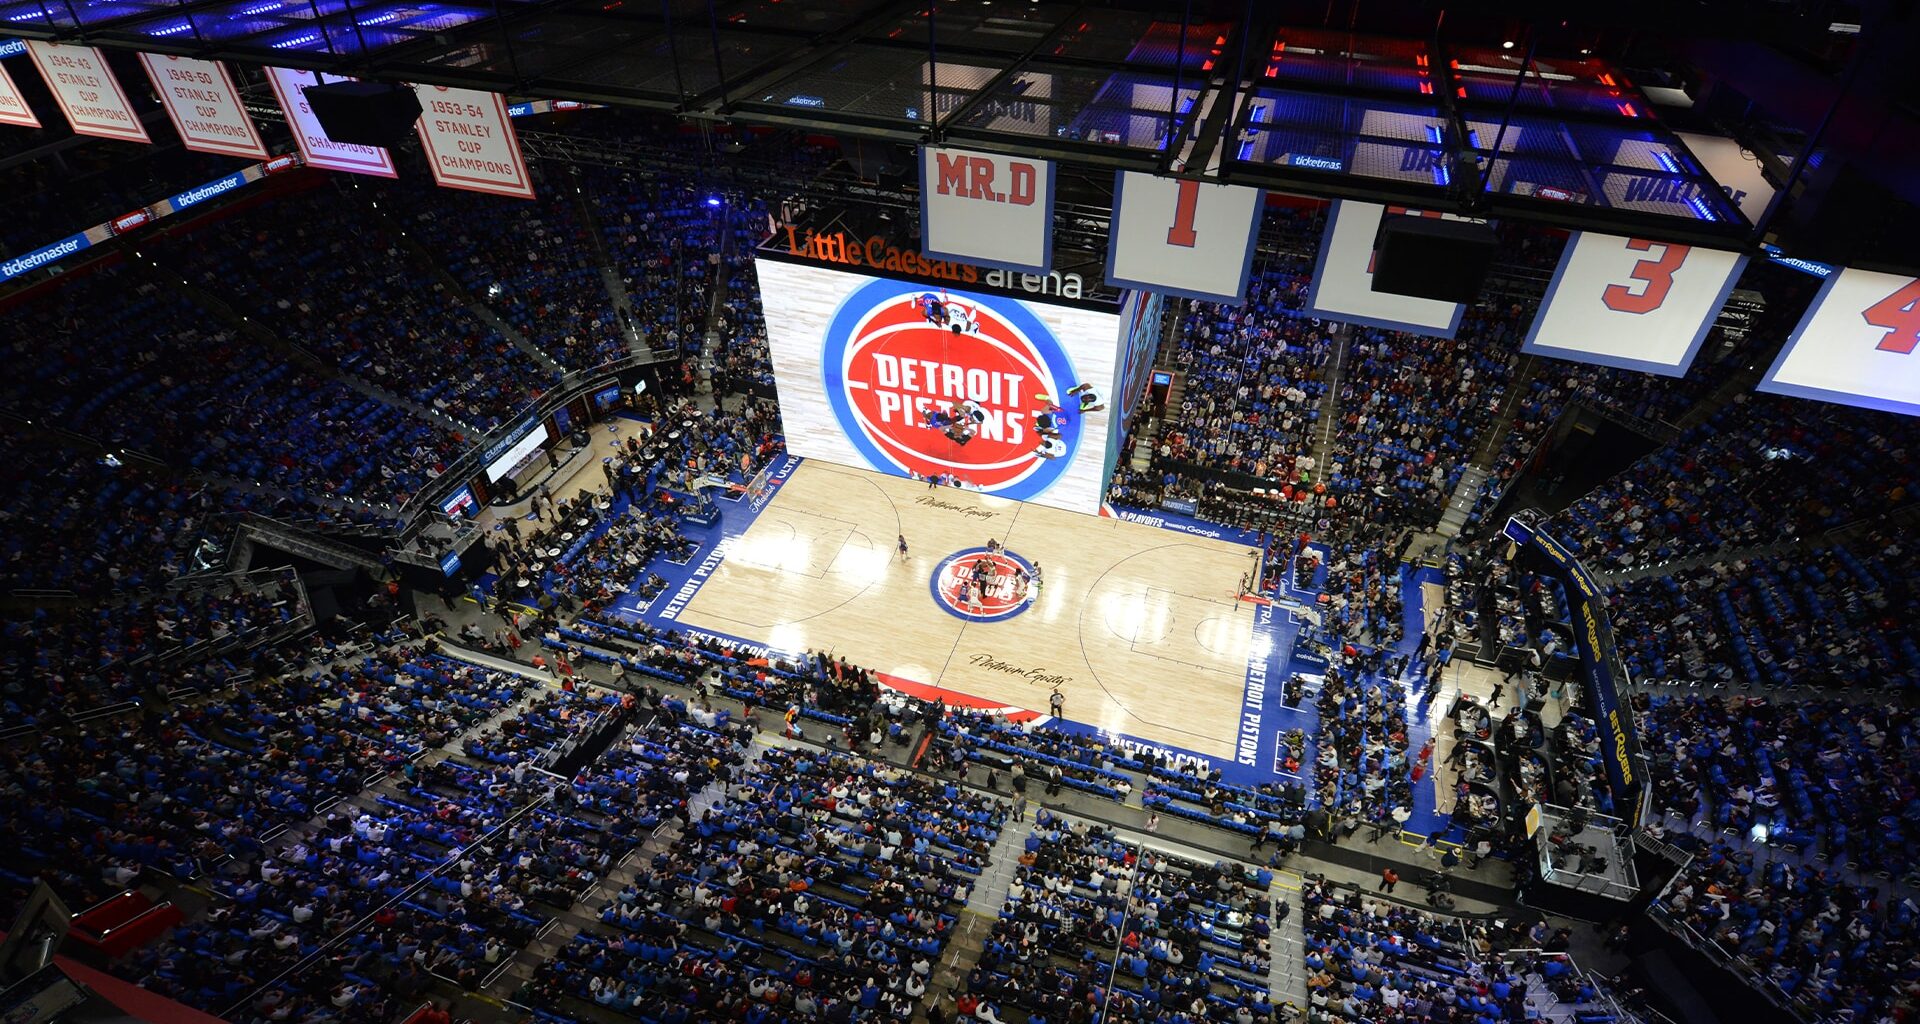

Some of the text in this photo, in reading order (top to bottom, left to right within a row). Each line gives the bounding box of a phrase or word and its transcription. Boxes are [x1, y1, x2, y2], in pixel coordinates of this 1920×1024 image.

[48, 55, 91, 70] 1942-43
[58, 72, 101, 89] STANLEY
[166, 68, 212, 85] 1949-50
[79, 90, 98, 103] CUP
[175, 87, 222, 103] STANLEY
[72, 104, 128, 122] CHAMPIONS
[196, 106, 216, 118] CUP
[430, 100, 484, 119] 1953-54
[185, 120, 247, 138] CHAMPIONS
[436, 119, 491, 139] STANLEY
[458, 140, 481, 154] CUP
[441, 155, 512, 176] CHAMPIONS
[1295, 156, 1342, 170] ticketmas
[936, 153, 1036, 207] MR.D
[178, 176, 238, 207] ticketmaster
[1166, 178, 1200, 248] 1
[784, 224, 862, 266] Little
[2, 239, 78, 277] ticketmaster
[1601, 238, 1691, 315] 3
[872, 352, 1024, 408] DETROIT
[874, 389, 1025, 445] PISTNS
[915, 495, 961, 513] Platinum
[1127, 512, 1164, 528] PLAYOFFS
[1187, 525, 1220, 538] Google
[658, 578, 702, 619] DETROIT
[969, 653, 1072, 690] Platinum Equity
[1238, 711, 1261, 767] PISTONS
